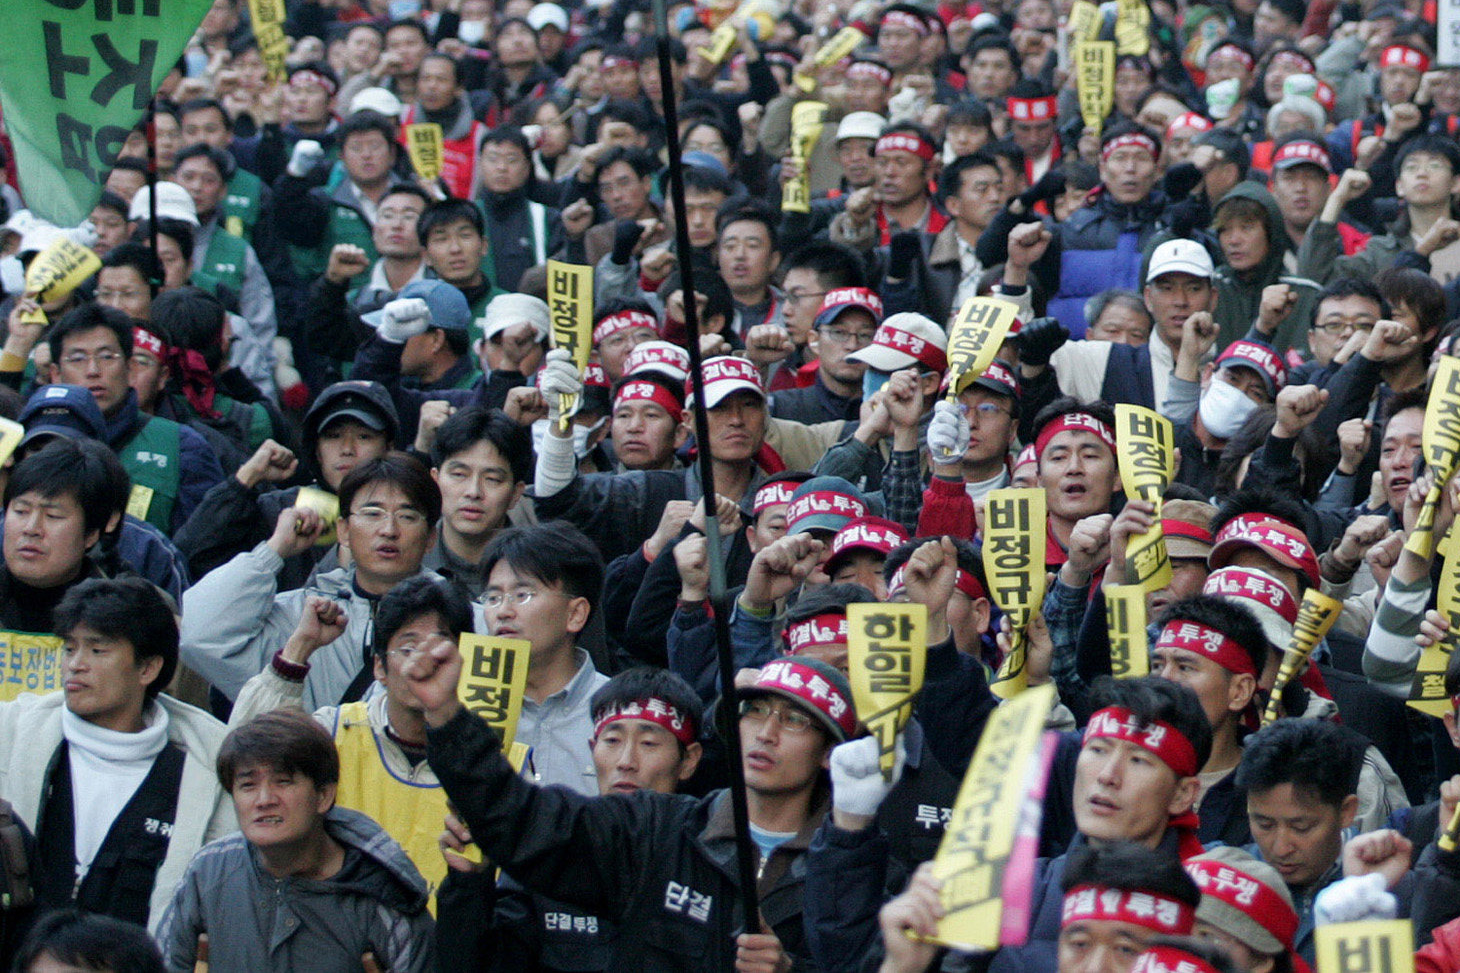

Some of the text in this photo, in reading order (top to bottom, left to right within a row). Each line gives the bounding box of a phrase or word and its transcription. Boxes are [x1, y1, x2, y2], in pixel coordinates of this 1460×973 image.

[622, 383, 655, 399] 투쟁
[136, 451, 168, 468] 투쟁
[833, 494, 867, 518] 투쟁
[1265, 529, 1306, 558] 투쟁
[1244, 575, 1286, 608] 투쟁
[1177, 622, 1225, 653] 투쟁
[863, 613, 915, 695] 한일
[805, 673, 848, 719] 투쟁
[665, 879, 713, 923] 단결
[1212, 867, 1260, 906] 투쟁
[544, 912, 600, 935] 단결 투쟁
[1124, 891, 1181, 927] 투쟁
